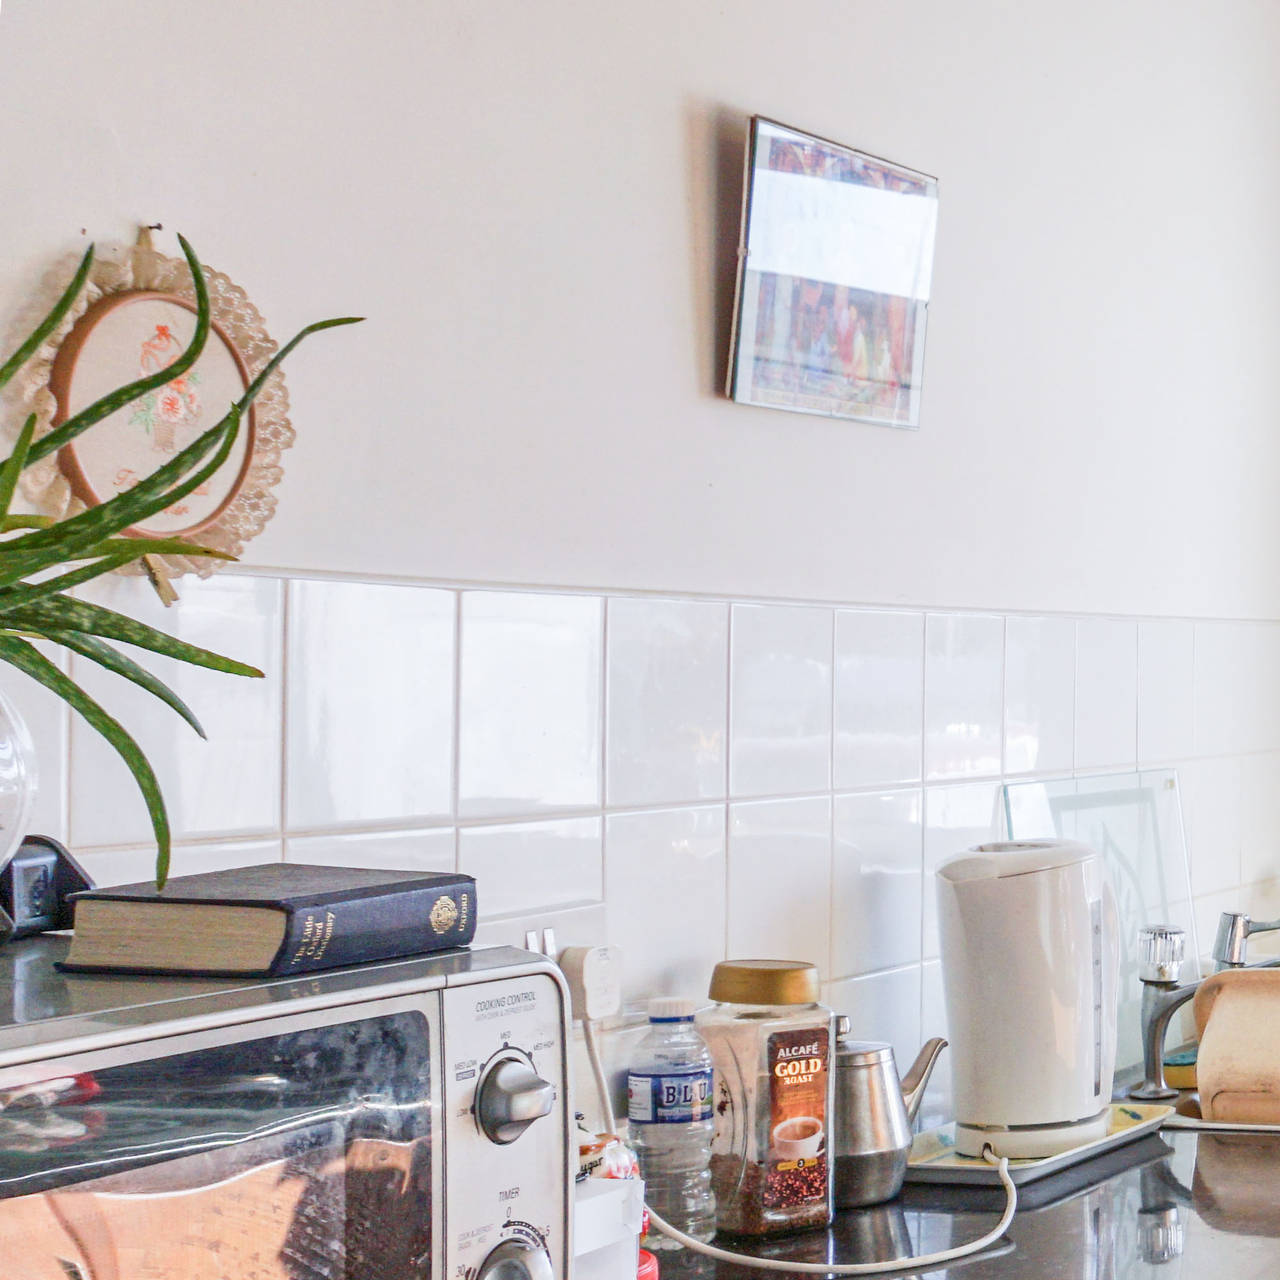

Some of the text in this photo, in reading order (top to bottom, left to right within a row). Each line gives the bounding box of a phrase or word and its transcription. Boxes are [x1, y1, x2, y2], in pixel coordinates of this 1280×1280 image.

[458, 893, 468, 932] OXFORD
[302, 915, 314, 943] Little
[306, 922, 324, 956] Oxford
[313, 911, 336, 960] Dictionary
[475, 996, 506, 1013] COOKING
[507, 991, 537, 1007] CONTROL
[777, 1041, 820, 1059] ALCAFÉ
[774, 1058, 822, 1078] GOLD
[783, 1073, 815, 1087] ROAST
[580, 1156, 604, 1177] ugar
[499, 1187, 520, 1202] TIMER
[506, 1206, 512, 1218] 0
[456, 1264, 466, 1278] 30
